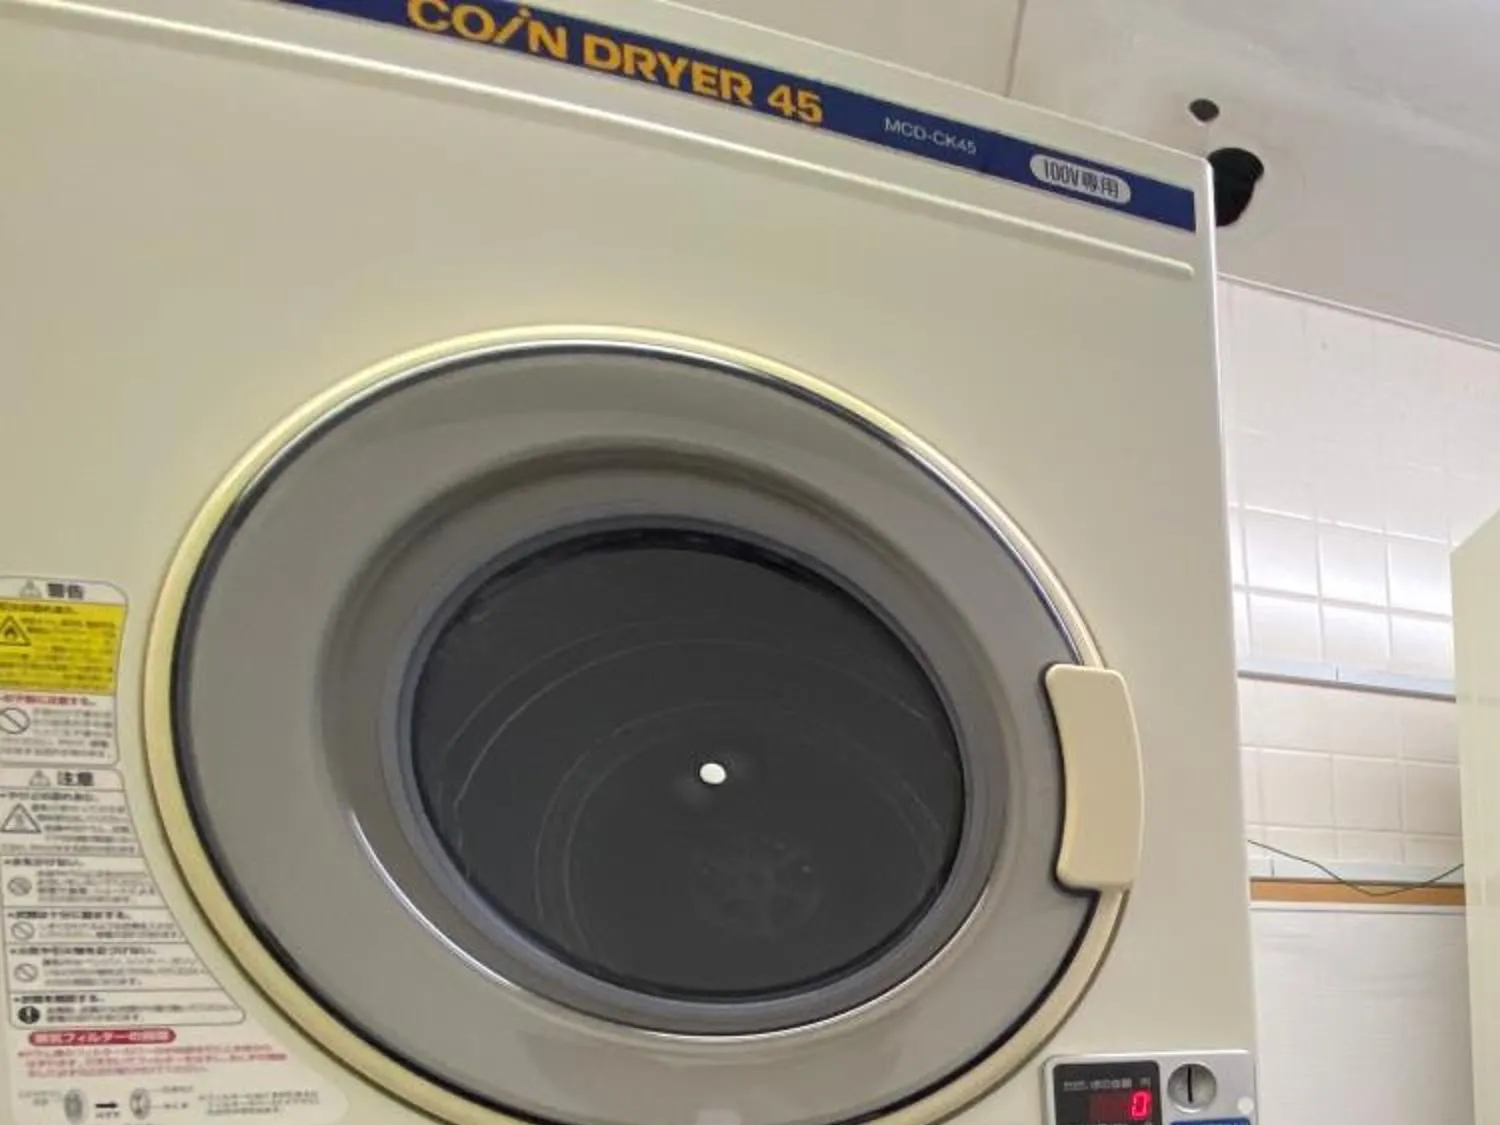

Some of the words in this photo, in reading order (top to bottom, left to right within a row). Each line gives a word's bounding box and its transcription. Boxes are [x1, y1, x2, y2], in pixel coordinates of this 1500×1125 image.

[582, 35, 752, 106] DRYER
[768, 84, 823, 125] 45
[884, 116, 977, 155] MCD-CK45
[1131, 1092, 1151, 1118] 0
